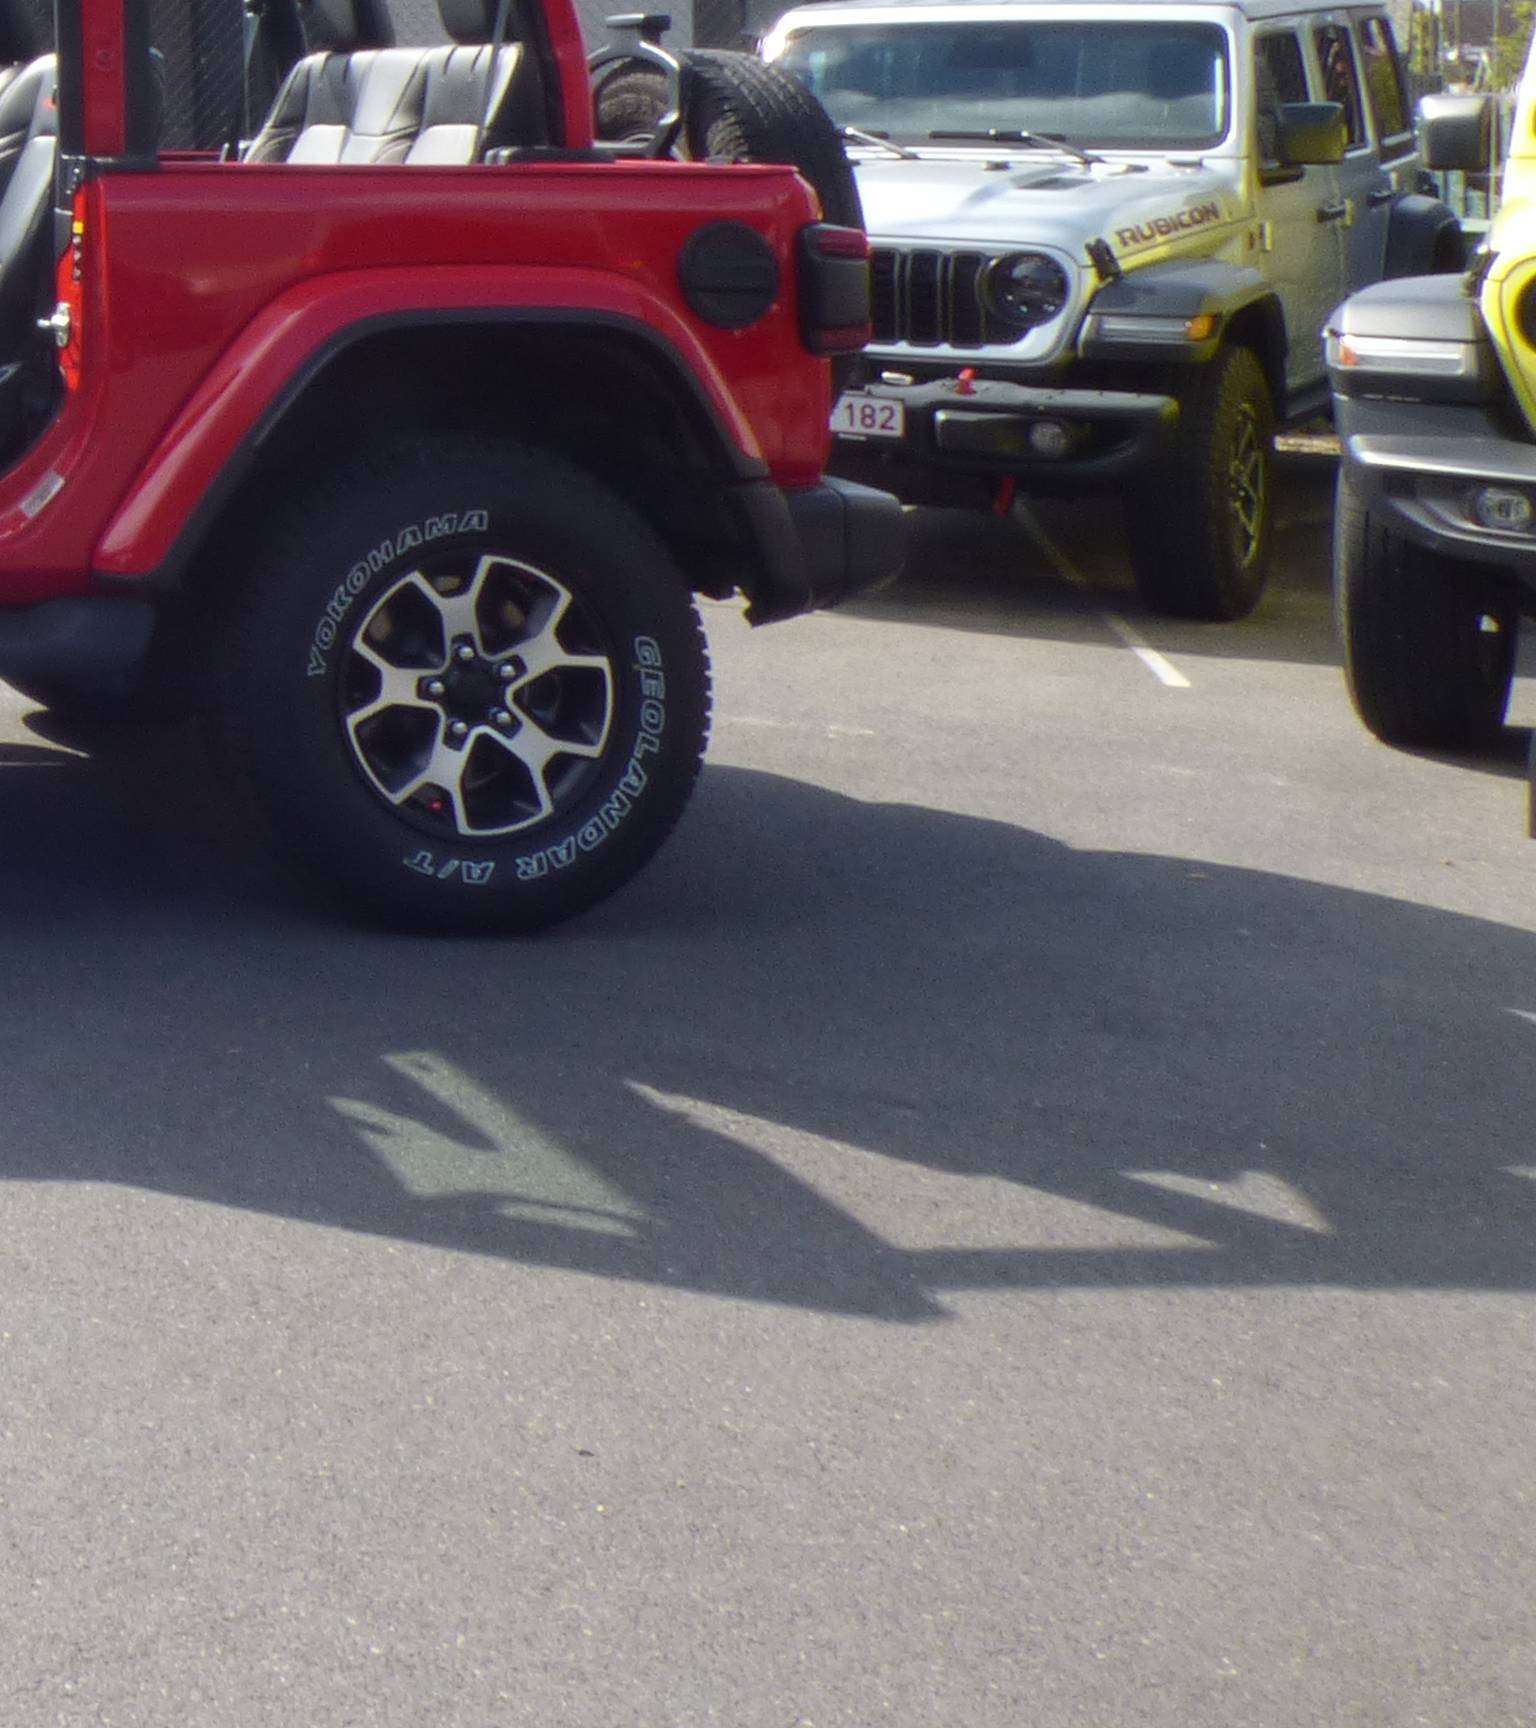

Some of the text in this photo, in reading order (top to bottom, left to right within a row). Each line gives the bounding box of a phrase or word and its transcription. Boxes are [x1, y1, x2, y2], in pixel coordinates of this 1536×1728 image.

[1115, 202, 1219, 247] RUBICON
[845, 402, 895, 430] 182
[306, 509, 489, 677] YOKOHAMA
[402, 635, 666, 884] GEOLANDAR A/T
